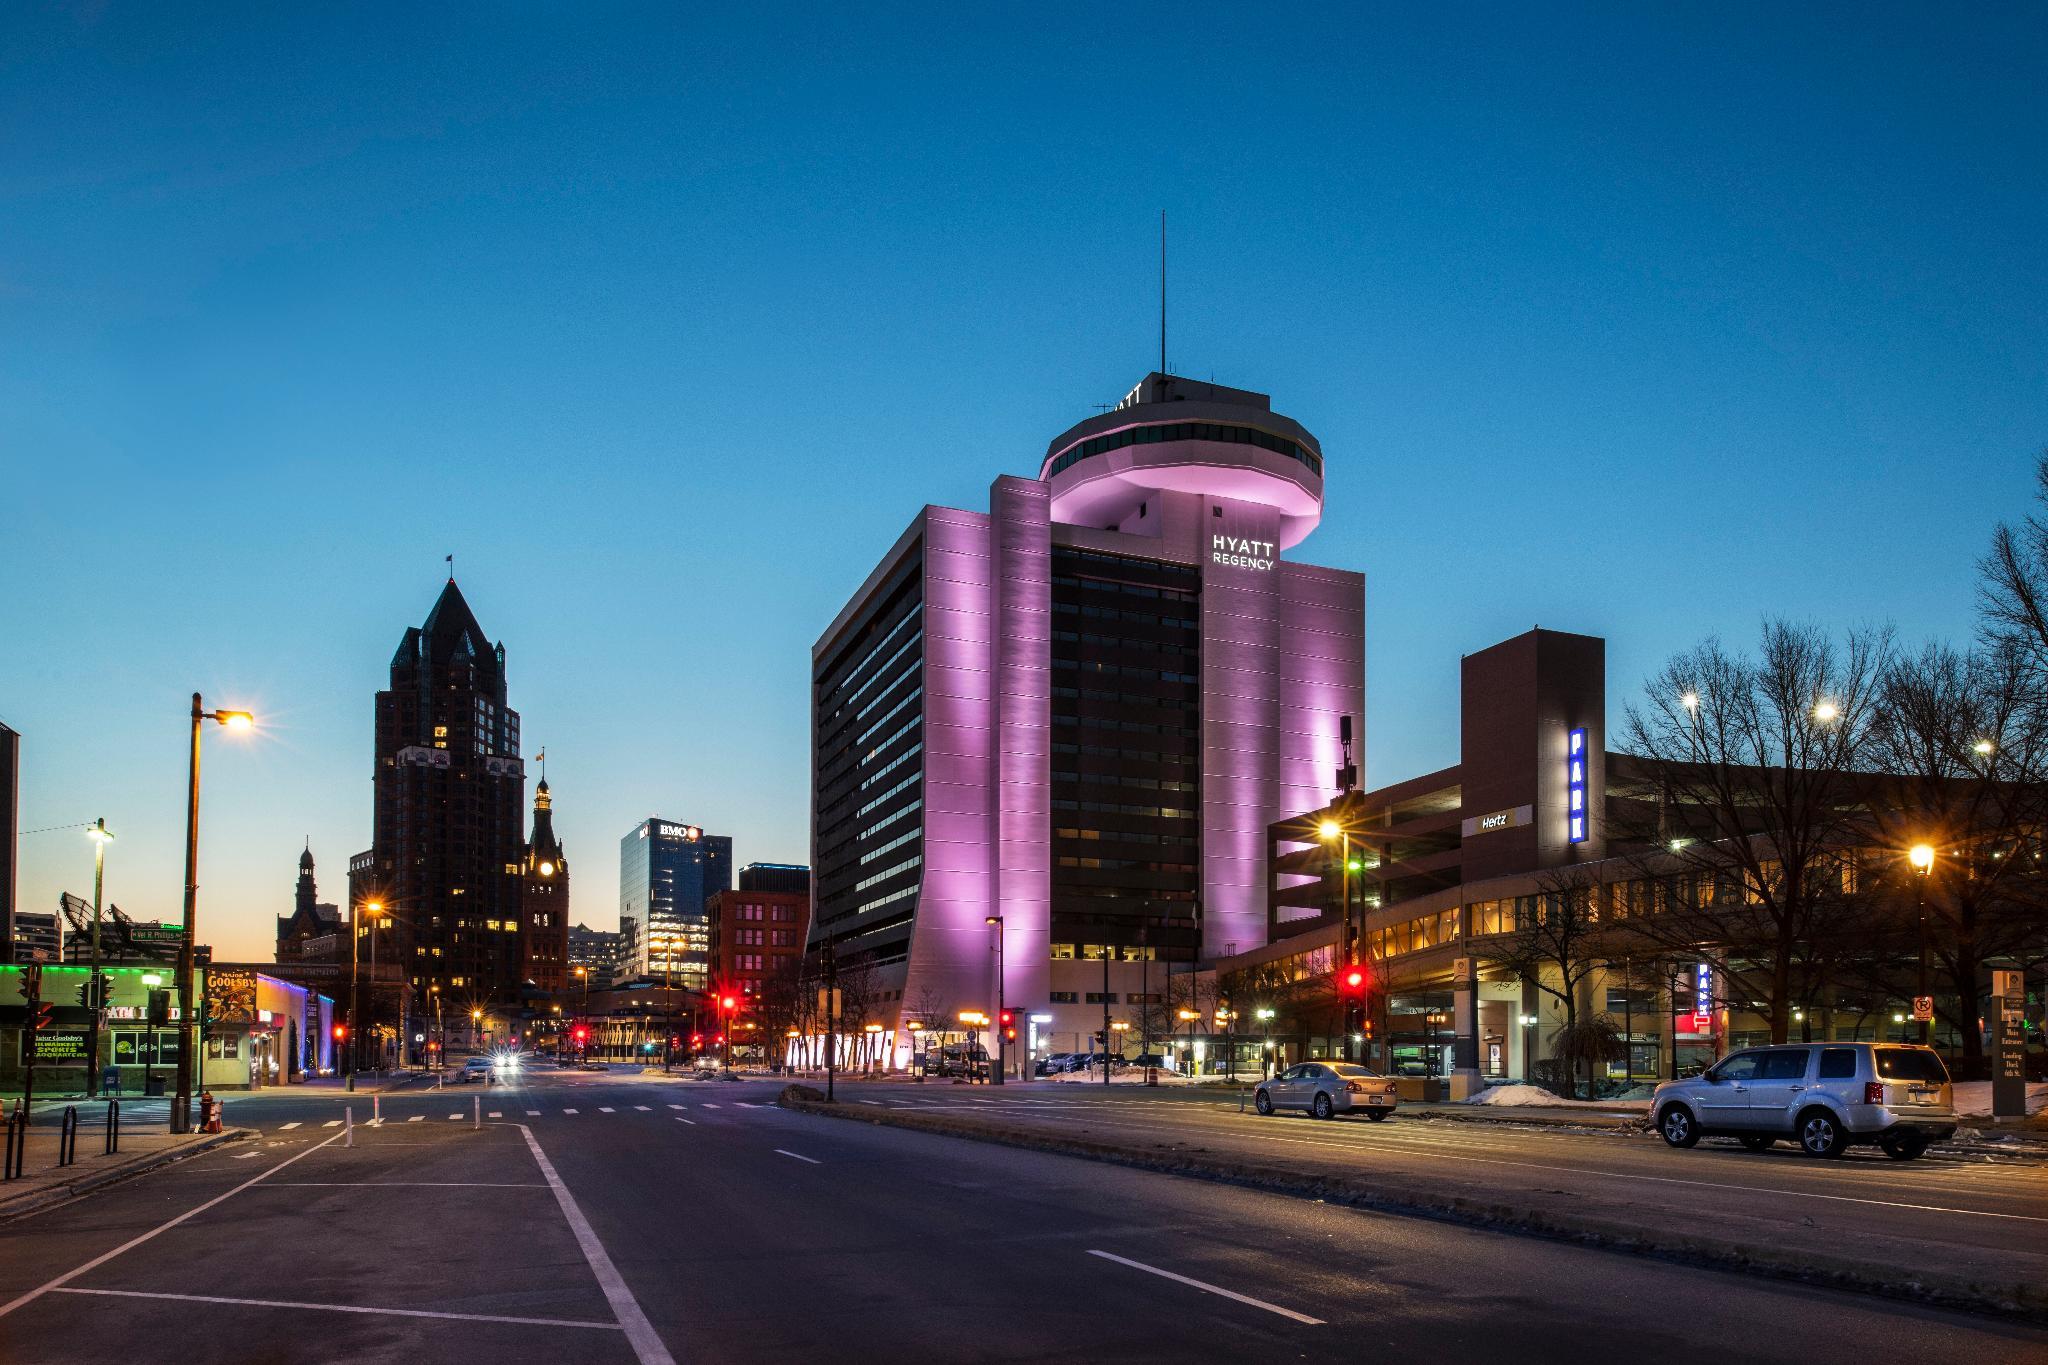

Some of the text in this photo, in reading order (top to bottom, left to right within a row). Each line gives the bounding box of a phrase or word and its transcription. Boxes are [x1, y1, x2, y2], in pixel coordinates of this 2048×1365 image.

[1213, 534, 1274, 557] HYATT
[1213, 552, 1274, 571] REGENCY
[1572, 733, 1582, 839] PARK
[1482, 814, 1507, 829] Hertz
[660, 824, 688, 837] BMO
[107, 1006, 134, 1019] ATM
[2002, 1051, 2022, 1060] Loading
